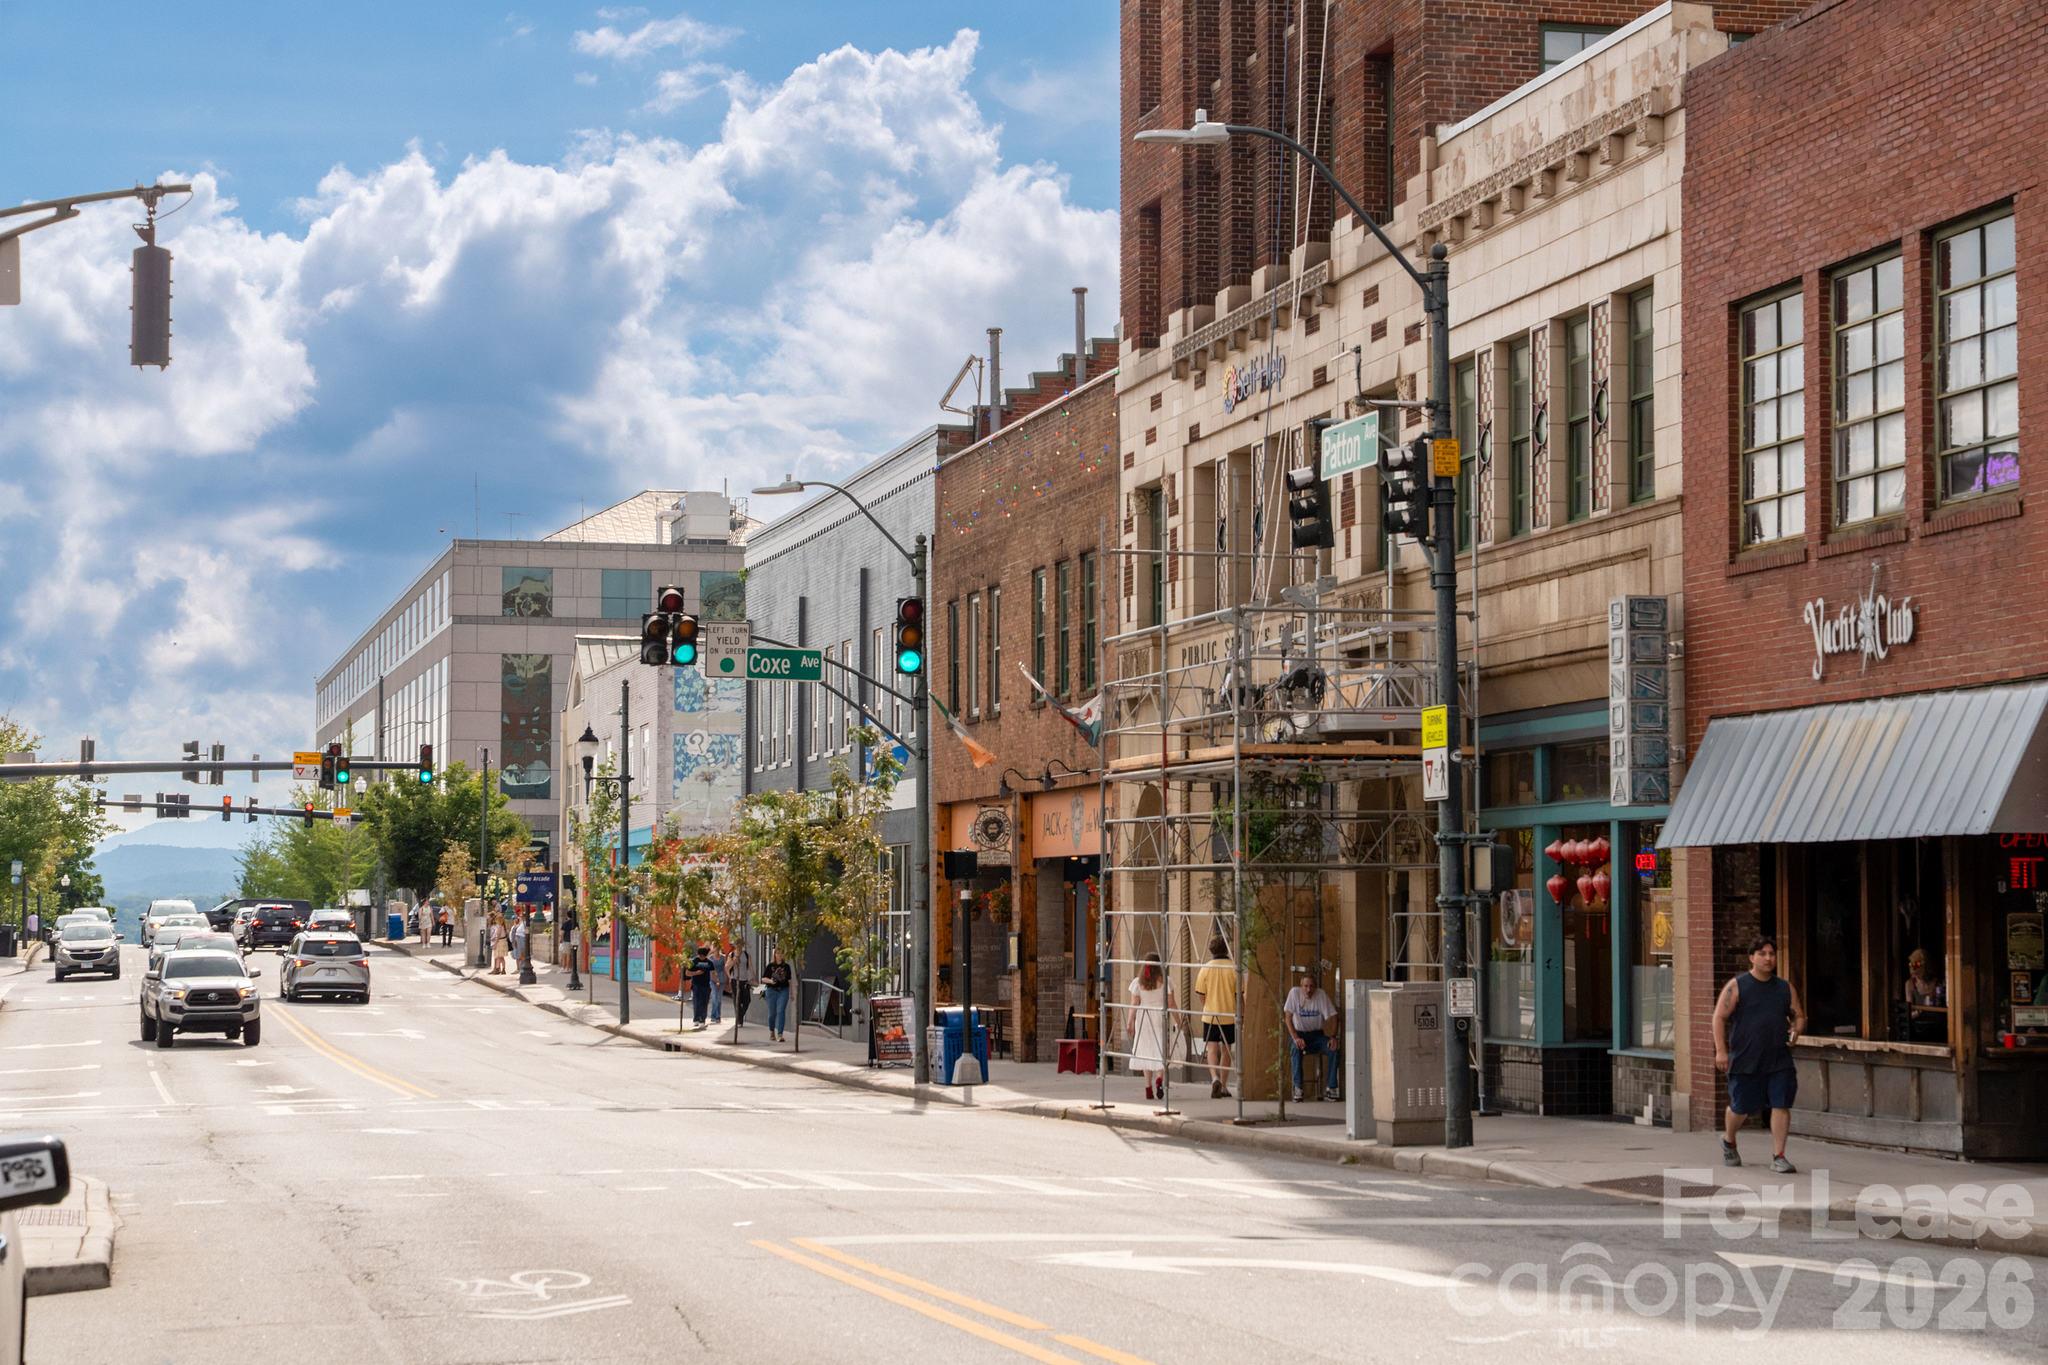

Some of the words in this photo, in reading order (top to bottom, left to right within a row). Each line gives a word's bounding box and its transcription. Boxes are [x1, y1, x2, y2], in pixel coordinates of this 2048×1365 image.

[1237, 346, 1286, 401] Self-Help
[1323, 431, 1361, 473] Patton
[1363, 422, 1377, 441] Ave
[708, 626, 724, 634] LEFT
[732, 626, 748, 634] TURN
[716, 636, 740, 645] YIELD
[1804, 597, 1857, 680] Yacht
[1875, 594, 1914, 660] Club
[749, 653, 791, 675] Coxe
[800, 655, 819, 668] Ave
[1181, 641, 1217, 668] PUBLIC
[1635, 853, 1658, 870] OPEN
